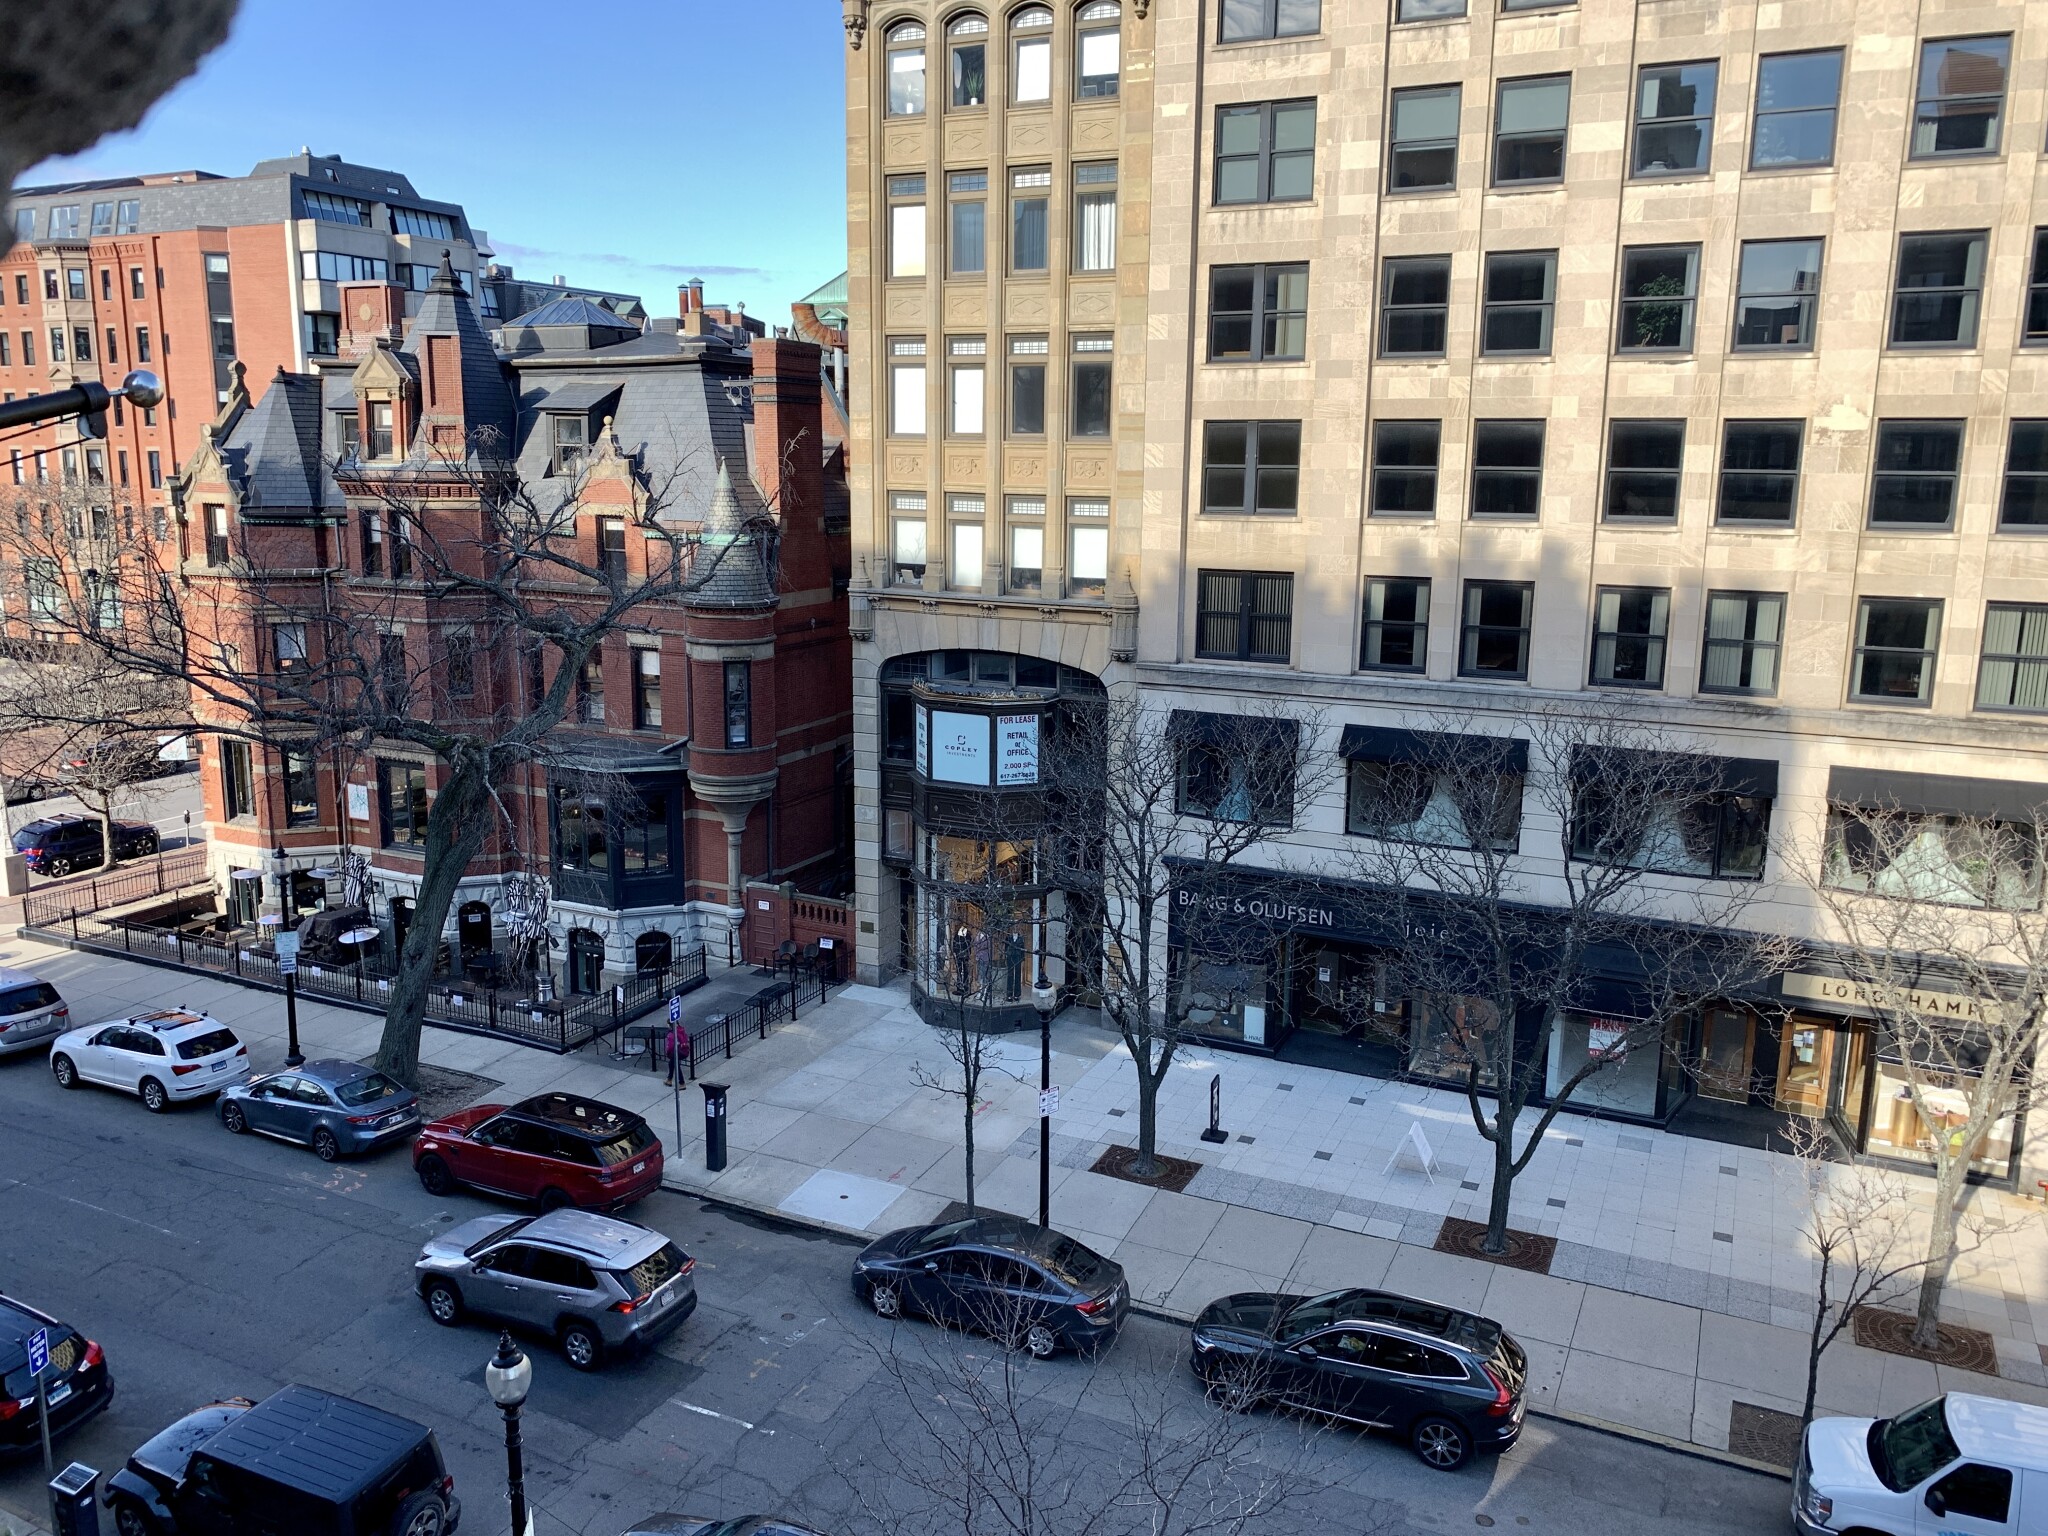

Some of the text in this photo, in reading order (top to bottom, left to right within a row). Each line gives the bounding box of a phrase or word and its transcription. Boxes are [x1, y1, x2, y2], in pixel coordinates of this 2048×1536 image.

[1000, 715, 1036, 725] FOR LEASE
[1007, 732, 1028, 740] RETAIL
[945, 745, 977, 753] COPLEY
[1006, 748, 1029, 756] OFFICE
[1233, 898, 1246, 914] &
[1250, 900, 1333, 926] OLUFSEN
